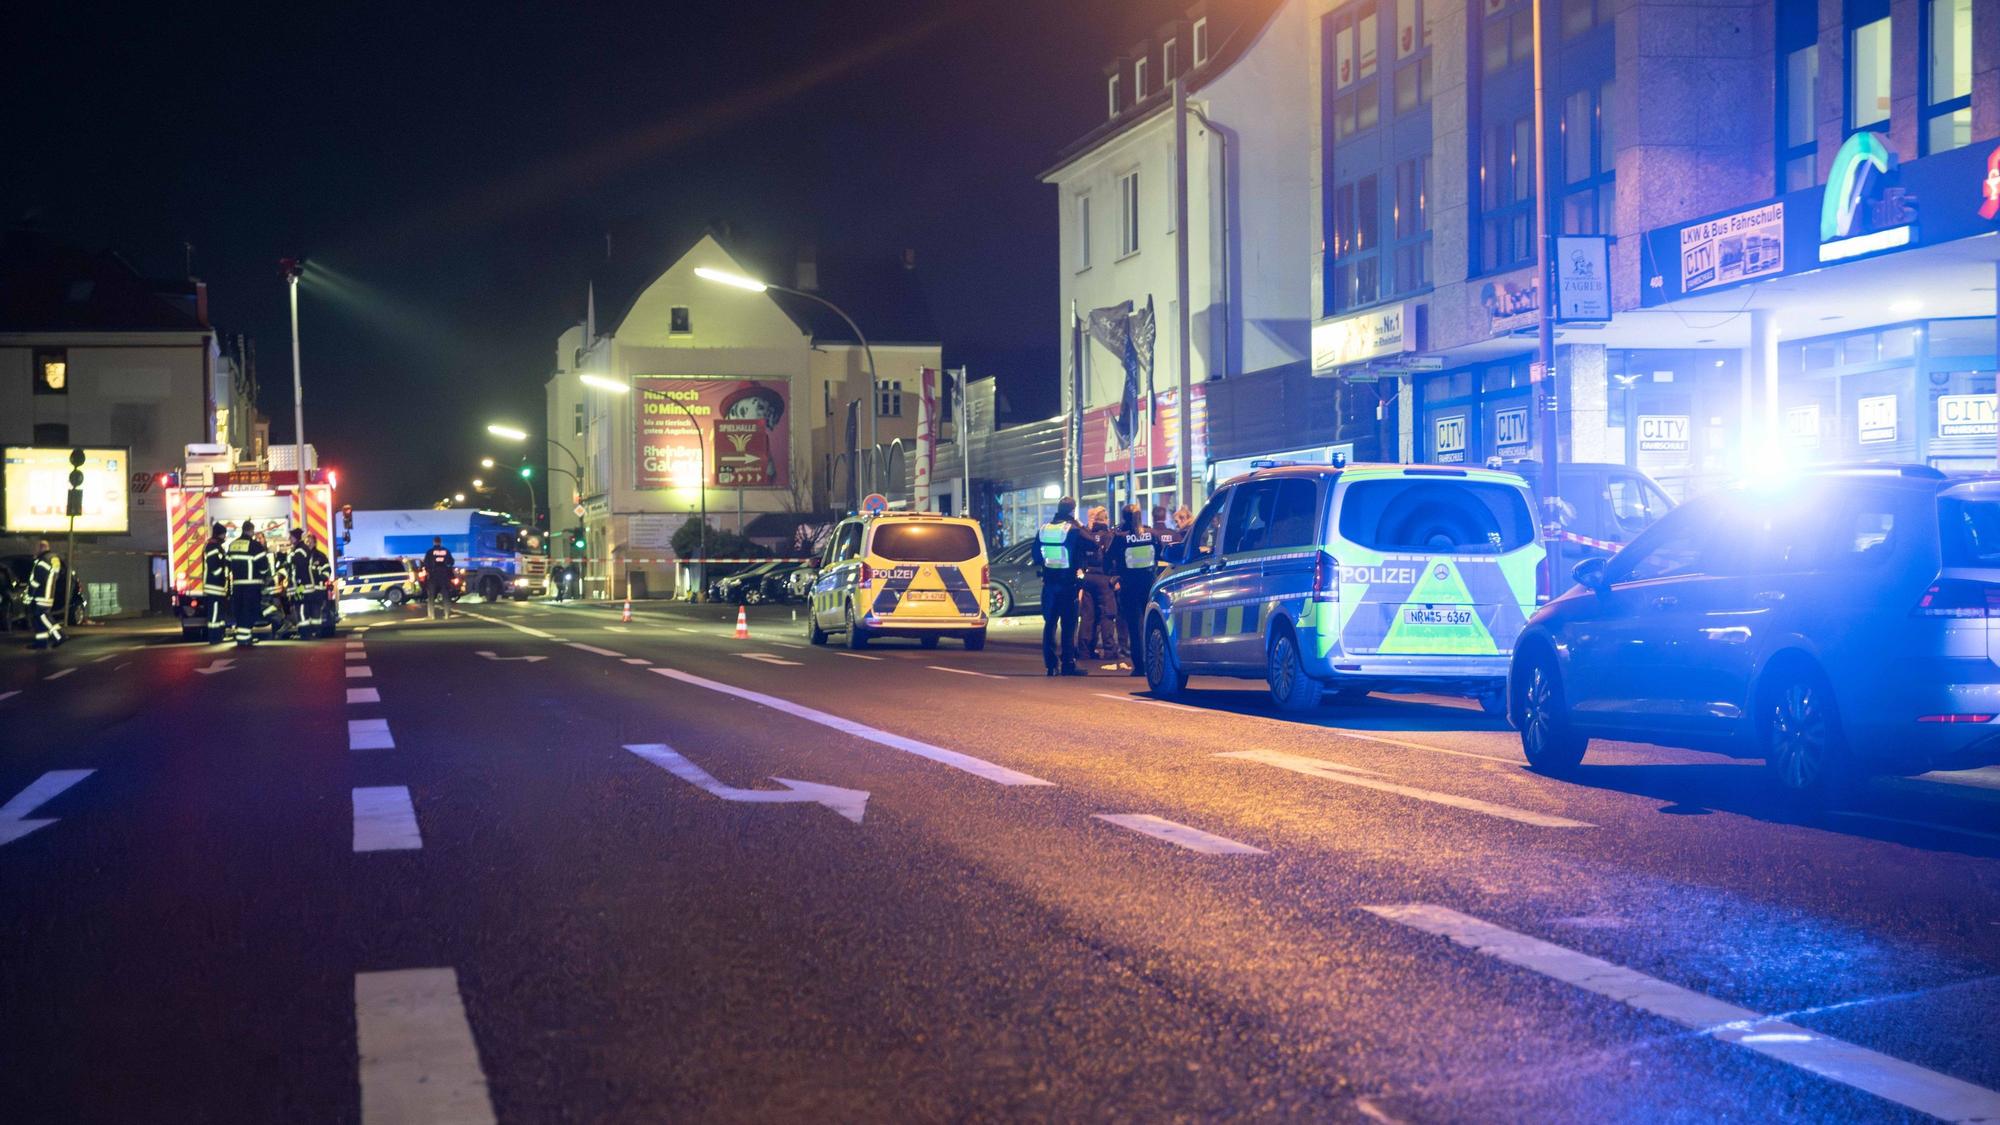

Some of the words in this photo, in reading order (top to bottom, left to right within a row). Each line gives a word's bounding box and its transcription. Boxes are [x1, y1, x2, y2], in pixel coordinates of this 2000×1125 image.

[1682, 228, 1701, 245] LKW
[1703, 226, 1711, 239] &
[1711, 222, 1729, 237] Bus
[1730, 206, 1783, 232] Fahrschule
[1686, 242, 1714, 275] CITY
[1564, 281, 1603, 292] ZAGREB
[668, 389, 699, 400] noch
[643, 403, 658, 415] 10
[658, 403, 711, 415] Minuten
[1946, 400, 1997, 422] CITY
[1439, 420, 1464, 449] CITY
[1498, 412, 1526, 442] CITY
[1643, 420, 1685, 438] CITY
[1945, 425, 1997, 435] FAHRSCHUL
[871, 569, 914, 579] POLIZEI
[1341, 566, 1416, 584] POLIZEI
